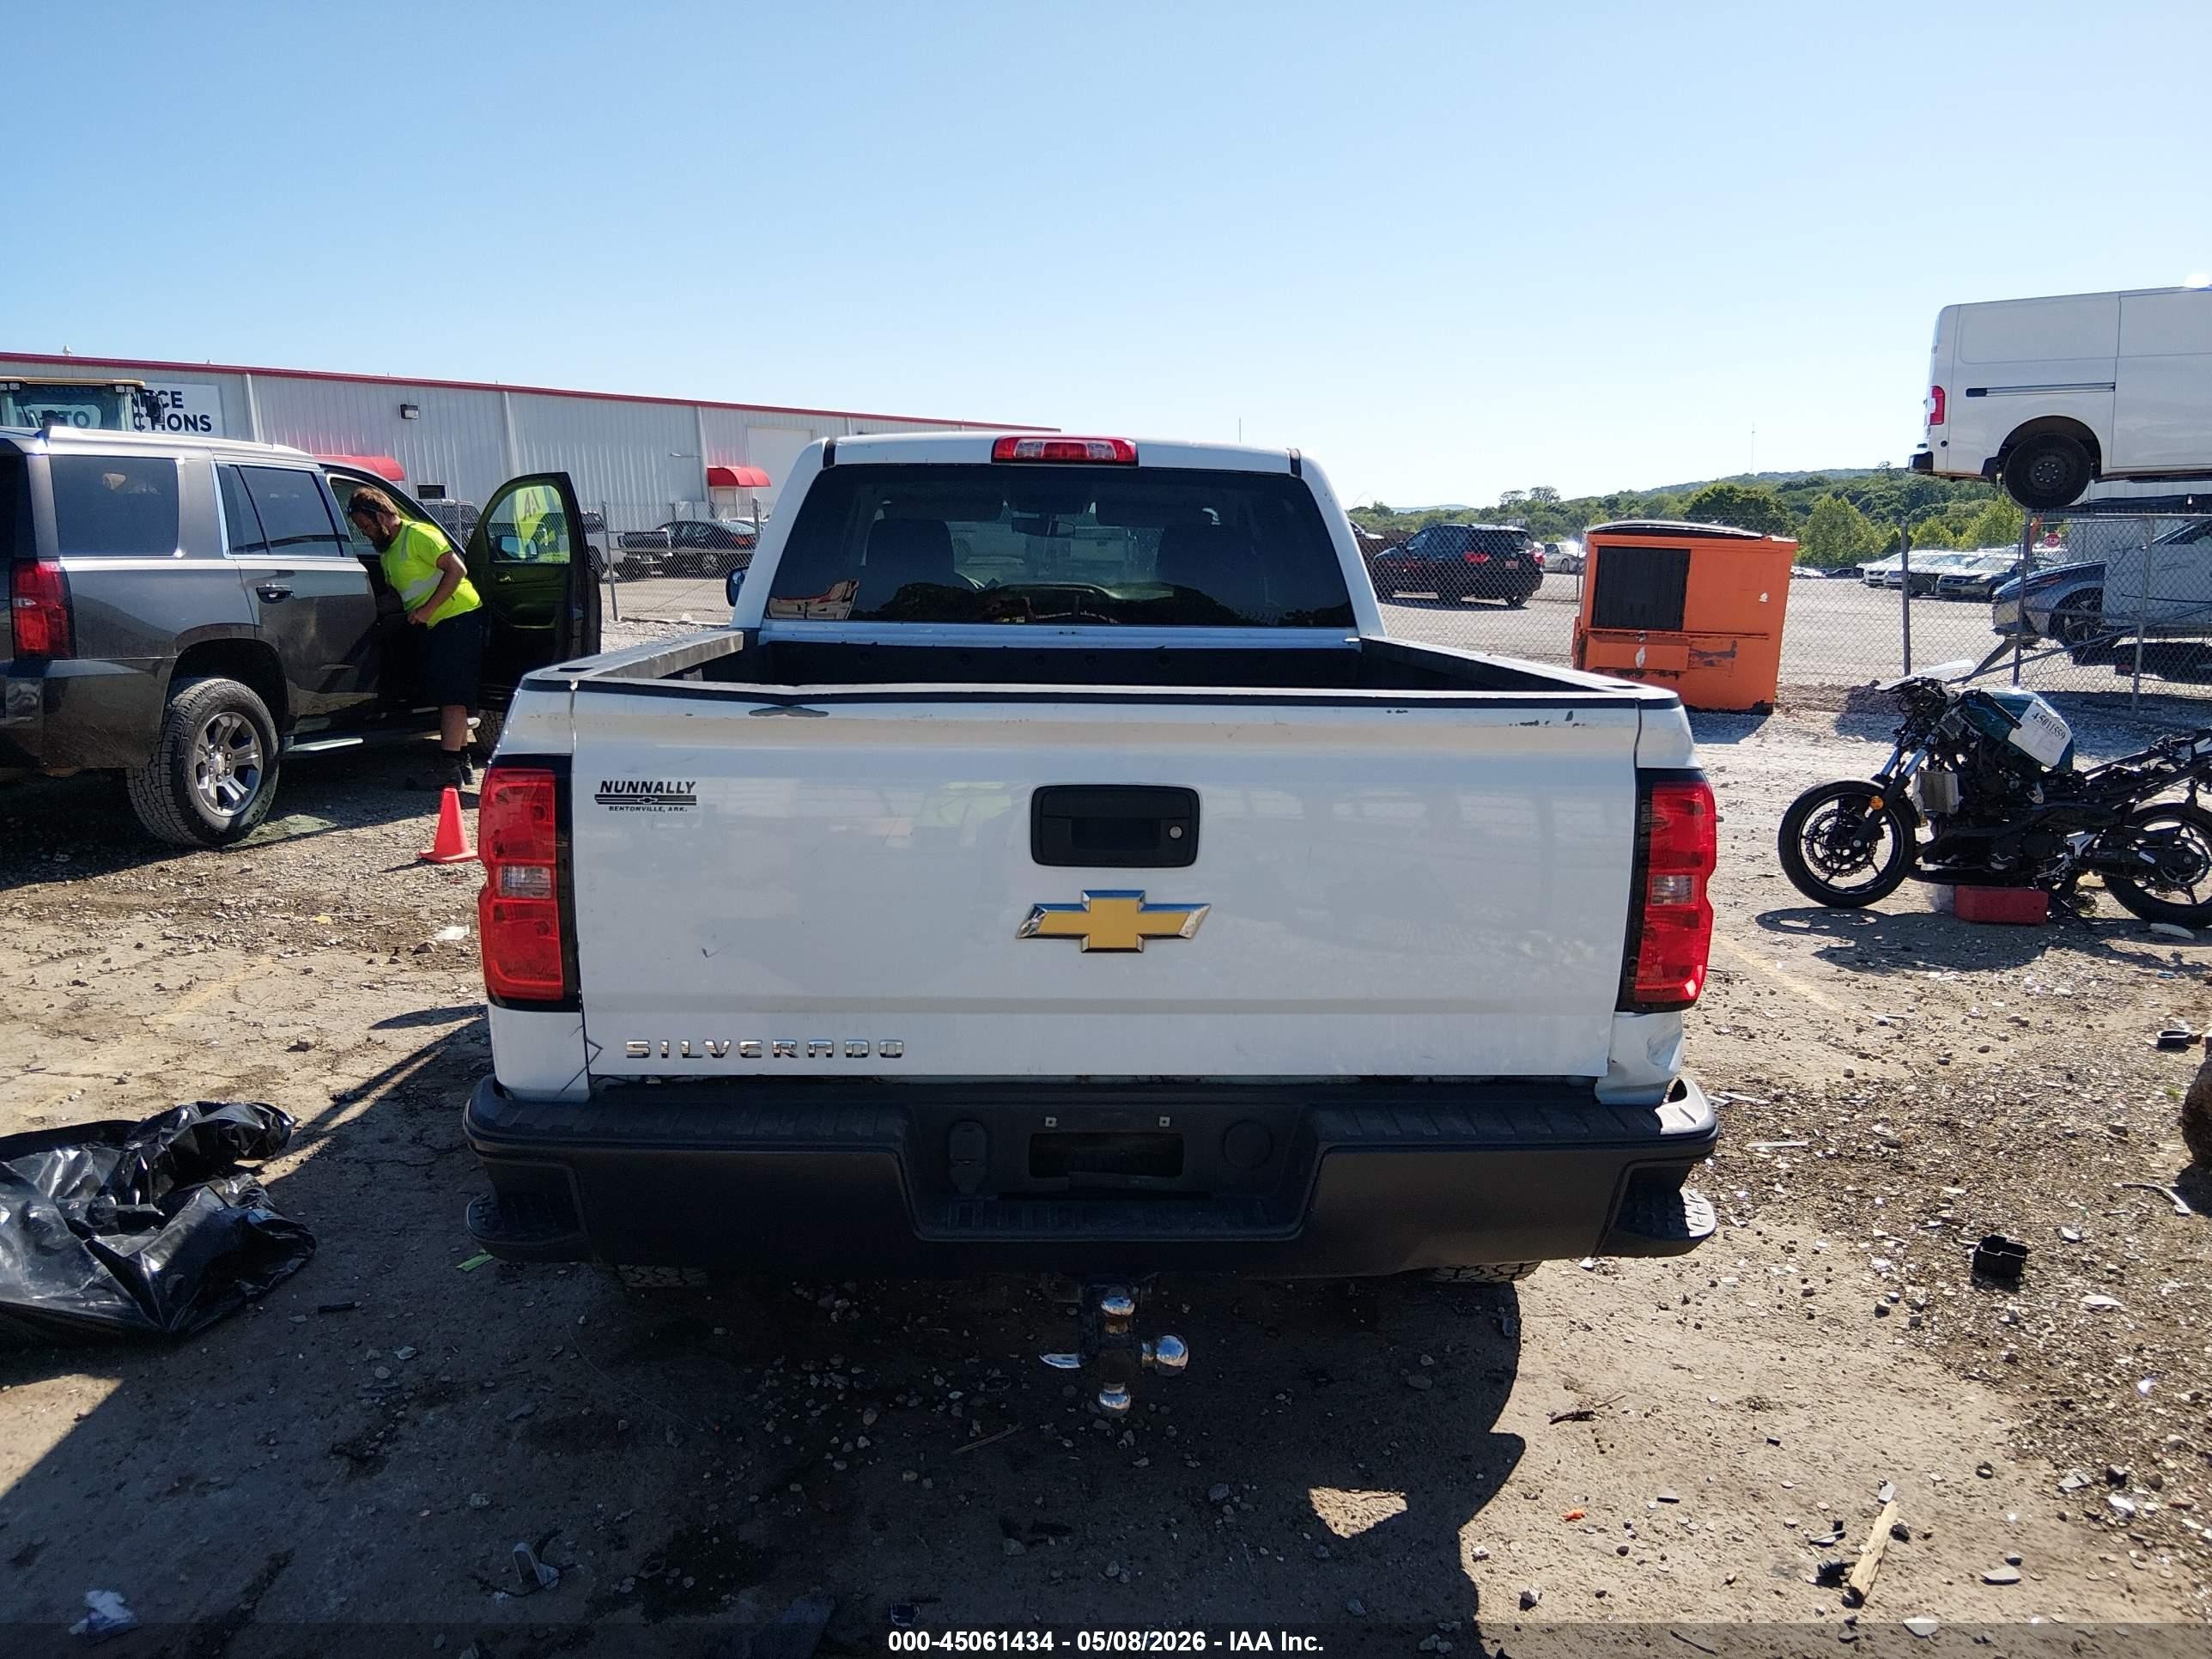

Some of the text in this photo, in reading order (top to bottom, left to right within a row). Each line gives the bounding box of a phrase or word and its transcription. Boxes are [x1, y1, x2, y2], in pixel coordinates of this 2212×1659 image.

[2032, 712, 2066, 740] 45011559
[600, 780, 696, 793] NUNNALLY
[626, 1039, 904, 1059] SILVERADO
